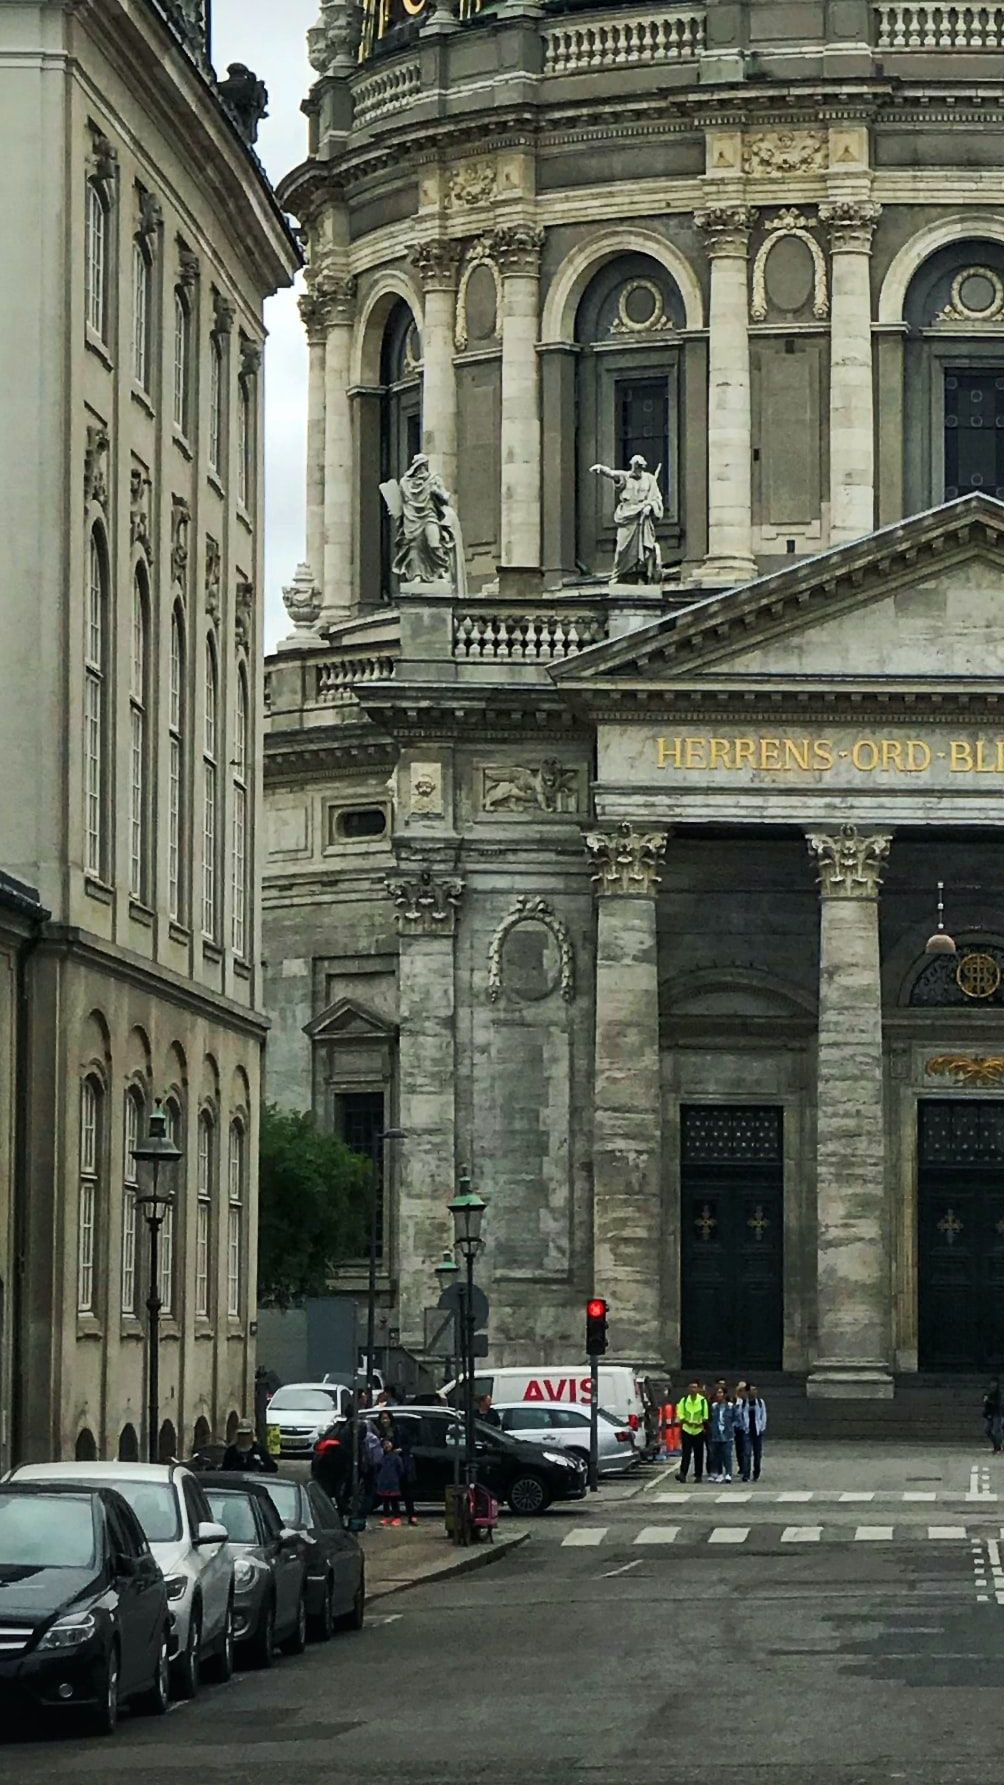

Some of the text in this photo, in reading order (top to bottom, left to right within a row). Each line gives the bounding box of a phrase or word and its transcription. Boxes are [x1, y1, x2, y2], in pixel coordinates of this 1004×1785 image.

[656, 737, 833, 771] HERRENS
[852, 739, 931, 772] ORD
[523, 1377, 592, 1404] AVIS
